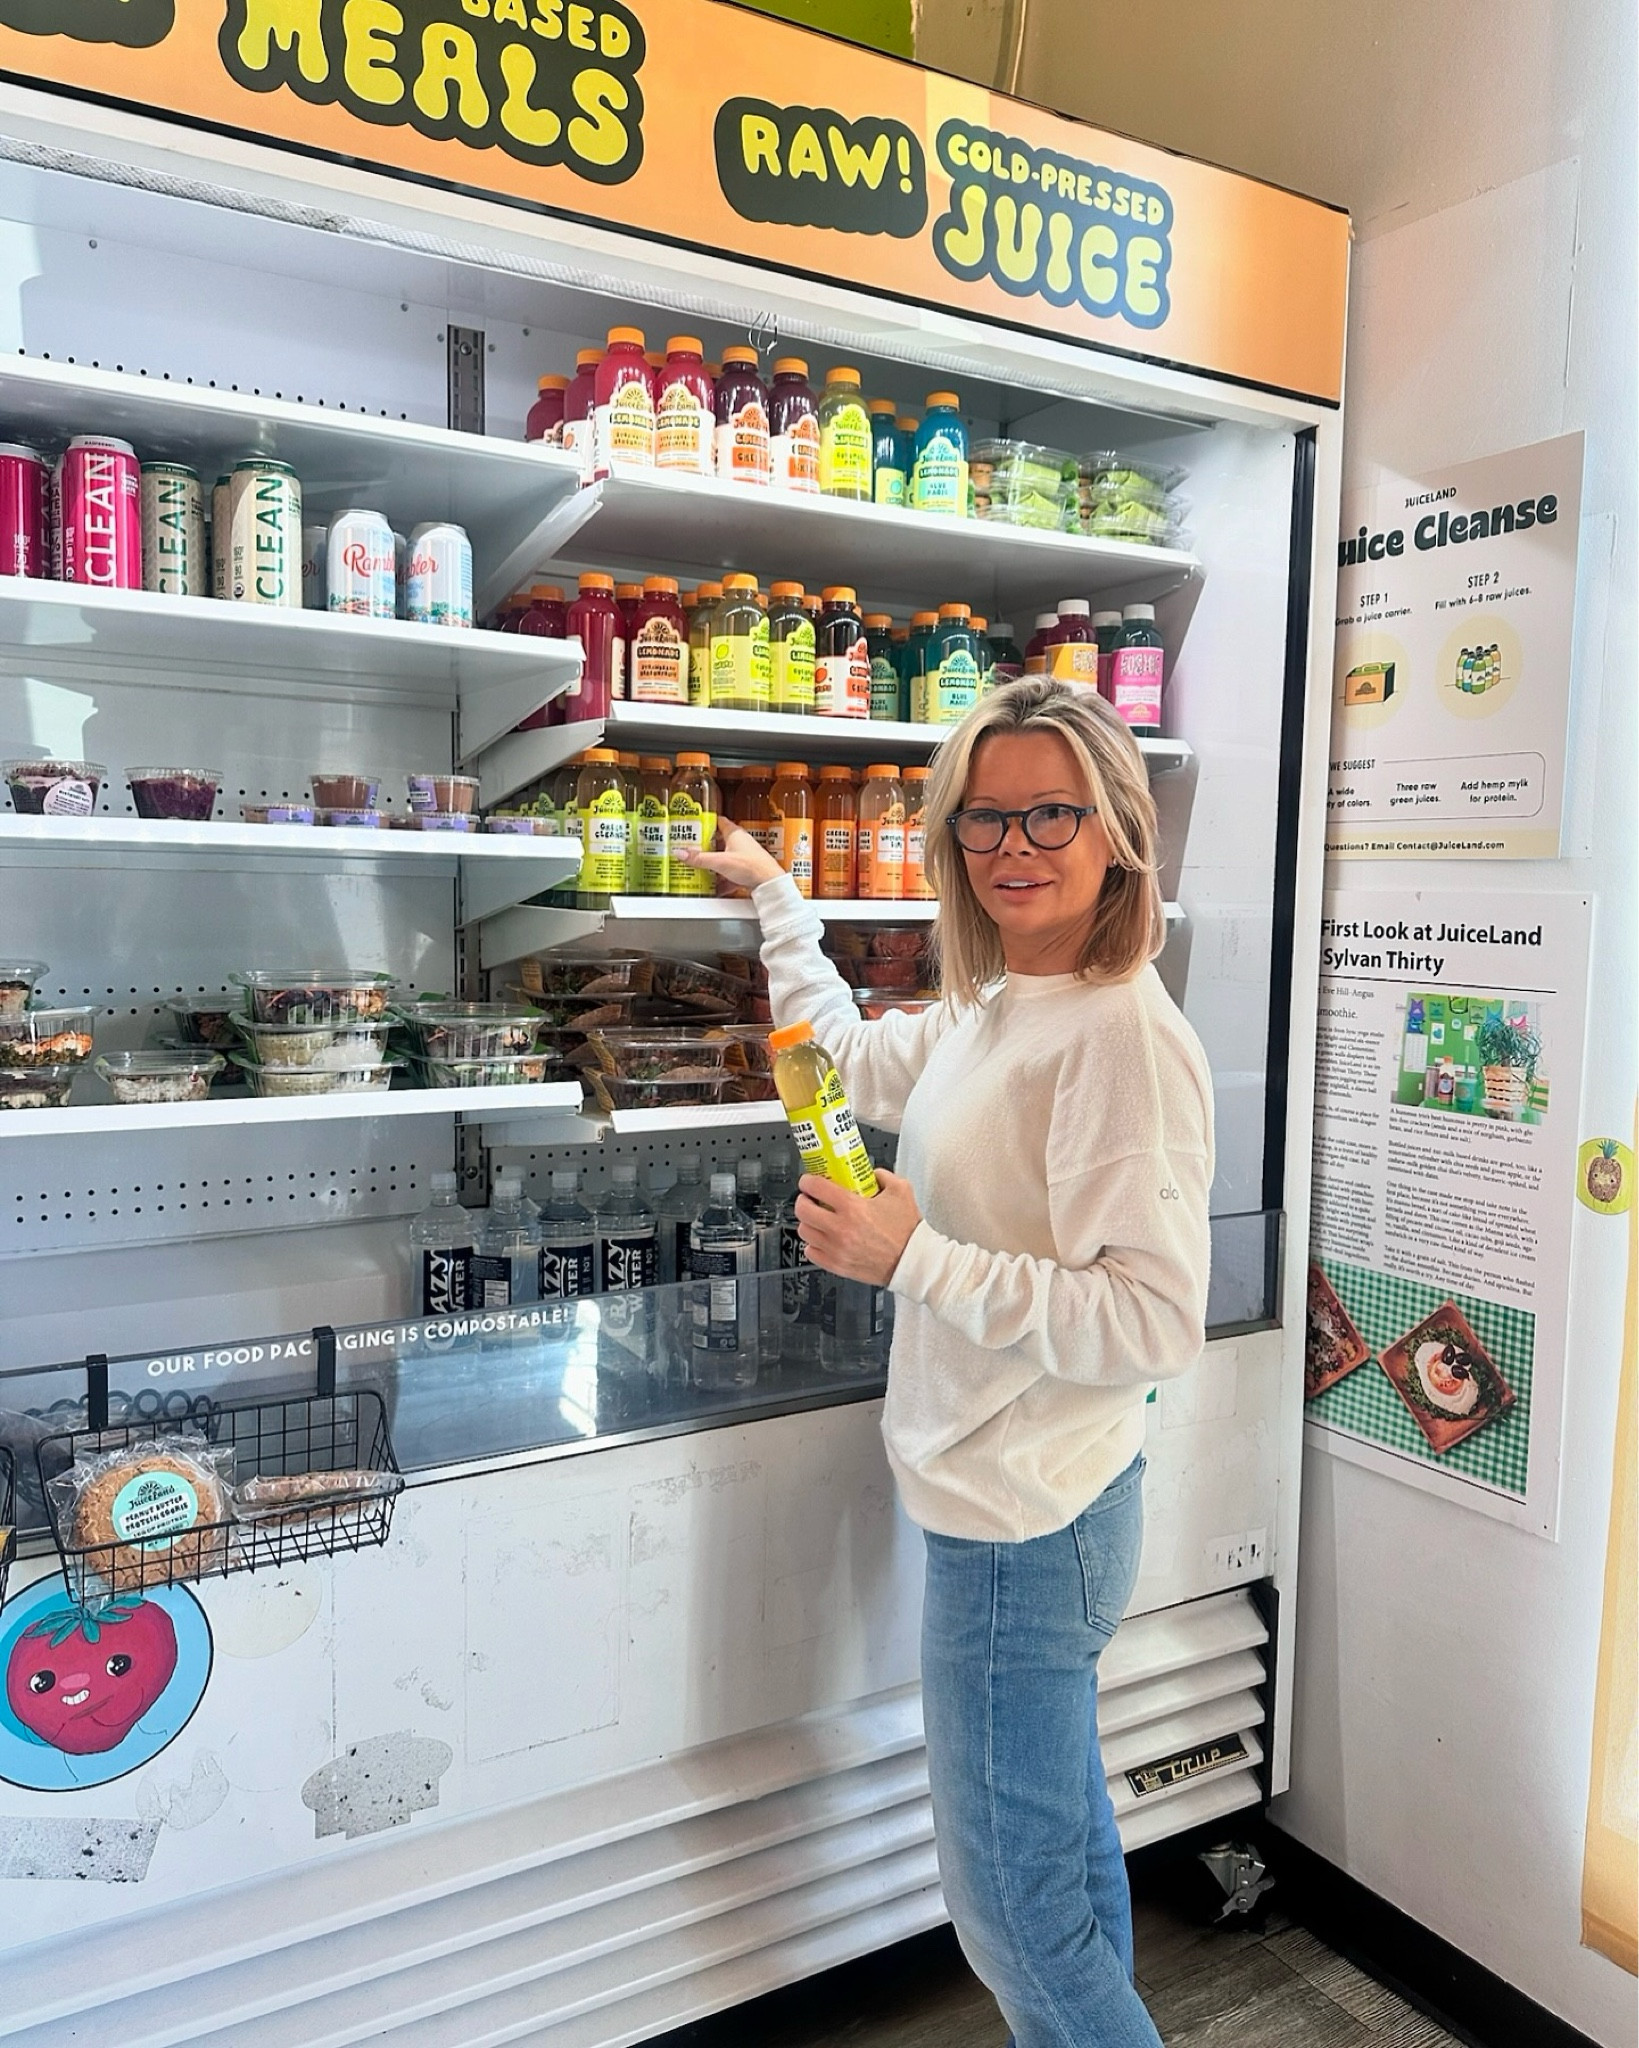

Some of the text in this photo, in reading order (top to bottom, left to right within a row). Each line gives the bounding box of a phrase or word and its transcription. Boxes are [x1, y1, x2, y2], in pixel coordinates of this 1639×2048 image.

[238, 0, 629, 166] MEALS
[742, 114, 913, 194] RAW!
[948, 133, 1165, 226] COLD-PRESSED
[944, 184, 1164, 316] JUICE
[1405, 487, 1457, 508] JUICELAND
[85, 452, 116, 583] CLEAN
[158, 480, 188, 595] CLEAN
[256, 478, 284, 599] CLEAN
[1337, 495, 1558, 567] uice Cleanse
[343, 544, 395, 578] Rambl
[1468, 571, 1500, 588] STEP 2
[1360, 594, 1381, 607] STEP
[1435, 601, 1447, 610] Fill
[1449, 598, 1467, 608] with
[1486, 592, 1502, 601] raw
[1504, 587, 1532, 600] juices.
[1335, 617, 1354, 627] Grab
[1363, 612, 1382, 623] juice
[1385, 607, 1413, 619] carrier.
[637, 646, 680, 660] LEMONADE
[1343, 759, 1376, 770] SUGGEST
[1336, 787, 1354, 795] wide
[1396, 783, 1437, 791] Three raw
[1460, 781, 1479, 790] Add
[1481, 780, 1505, 792] hemp
[1390, 795, 1414, 806] green
[1469, 793, 1517, 804] for protein.
[1324, 842, 1369, 852] Questions?
[1371, 842, 1394, 851] Email
[1321, 919, 1542, 947] First Look at JuiceLand
[1323, 948, 1444, 976] Sylvan Thirty
[1322, 986, 1335, 995] Eve
[1317, 1006, 1358, 1019] moothie.
[148, 1308, 569, 1377] OUR FOOD PACAGING IS COMPOSTABLE!
[126, 1495, 183, 1522] PEANUT BUTTER
[129, 1485, 175, 1510] JuiceLand
[126, 1502, 188, 1532] PROTEIN COOKIE
